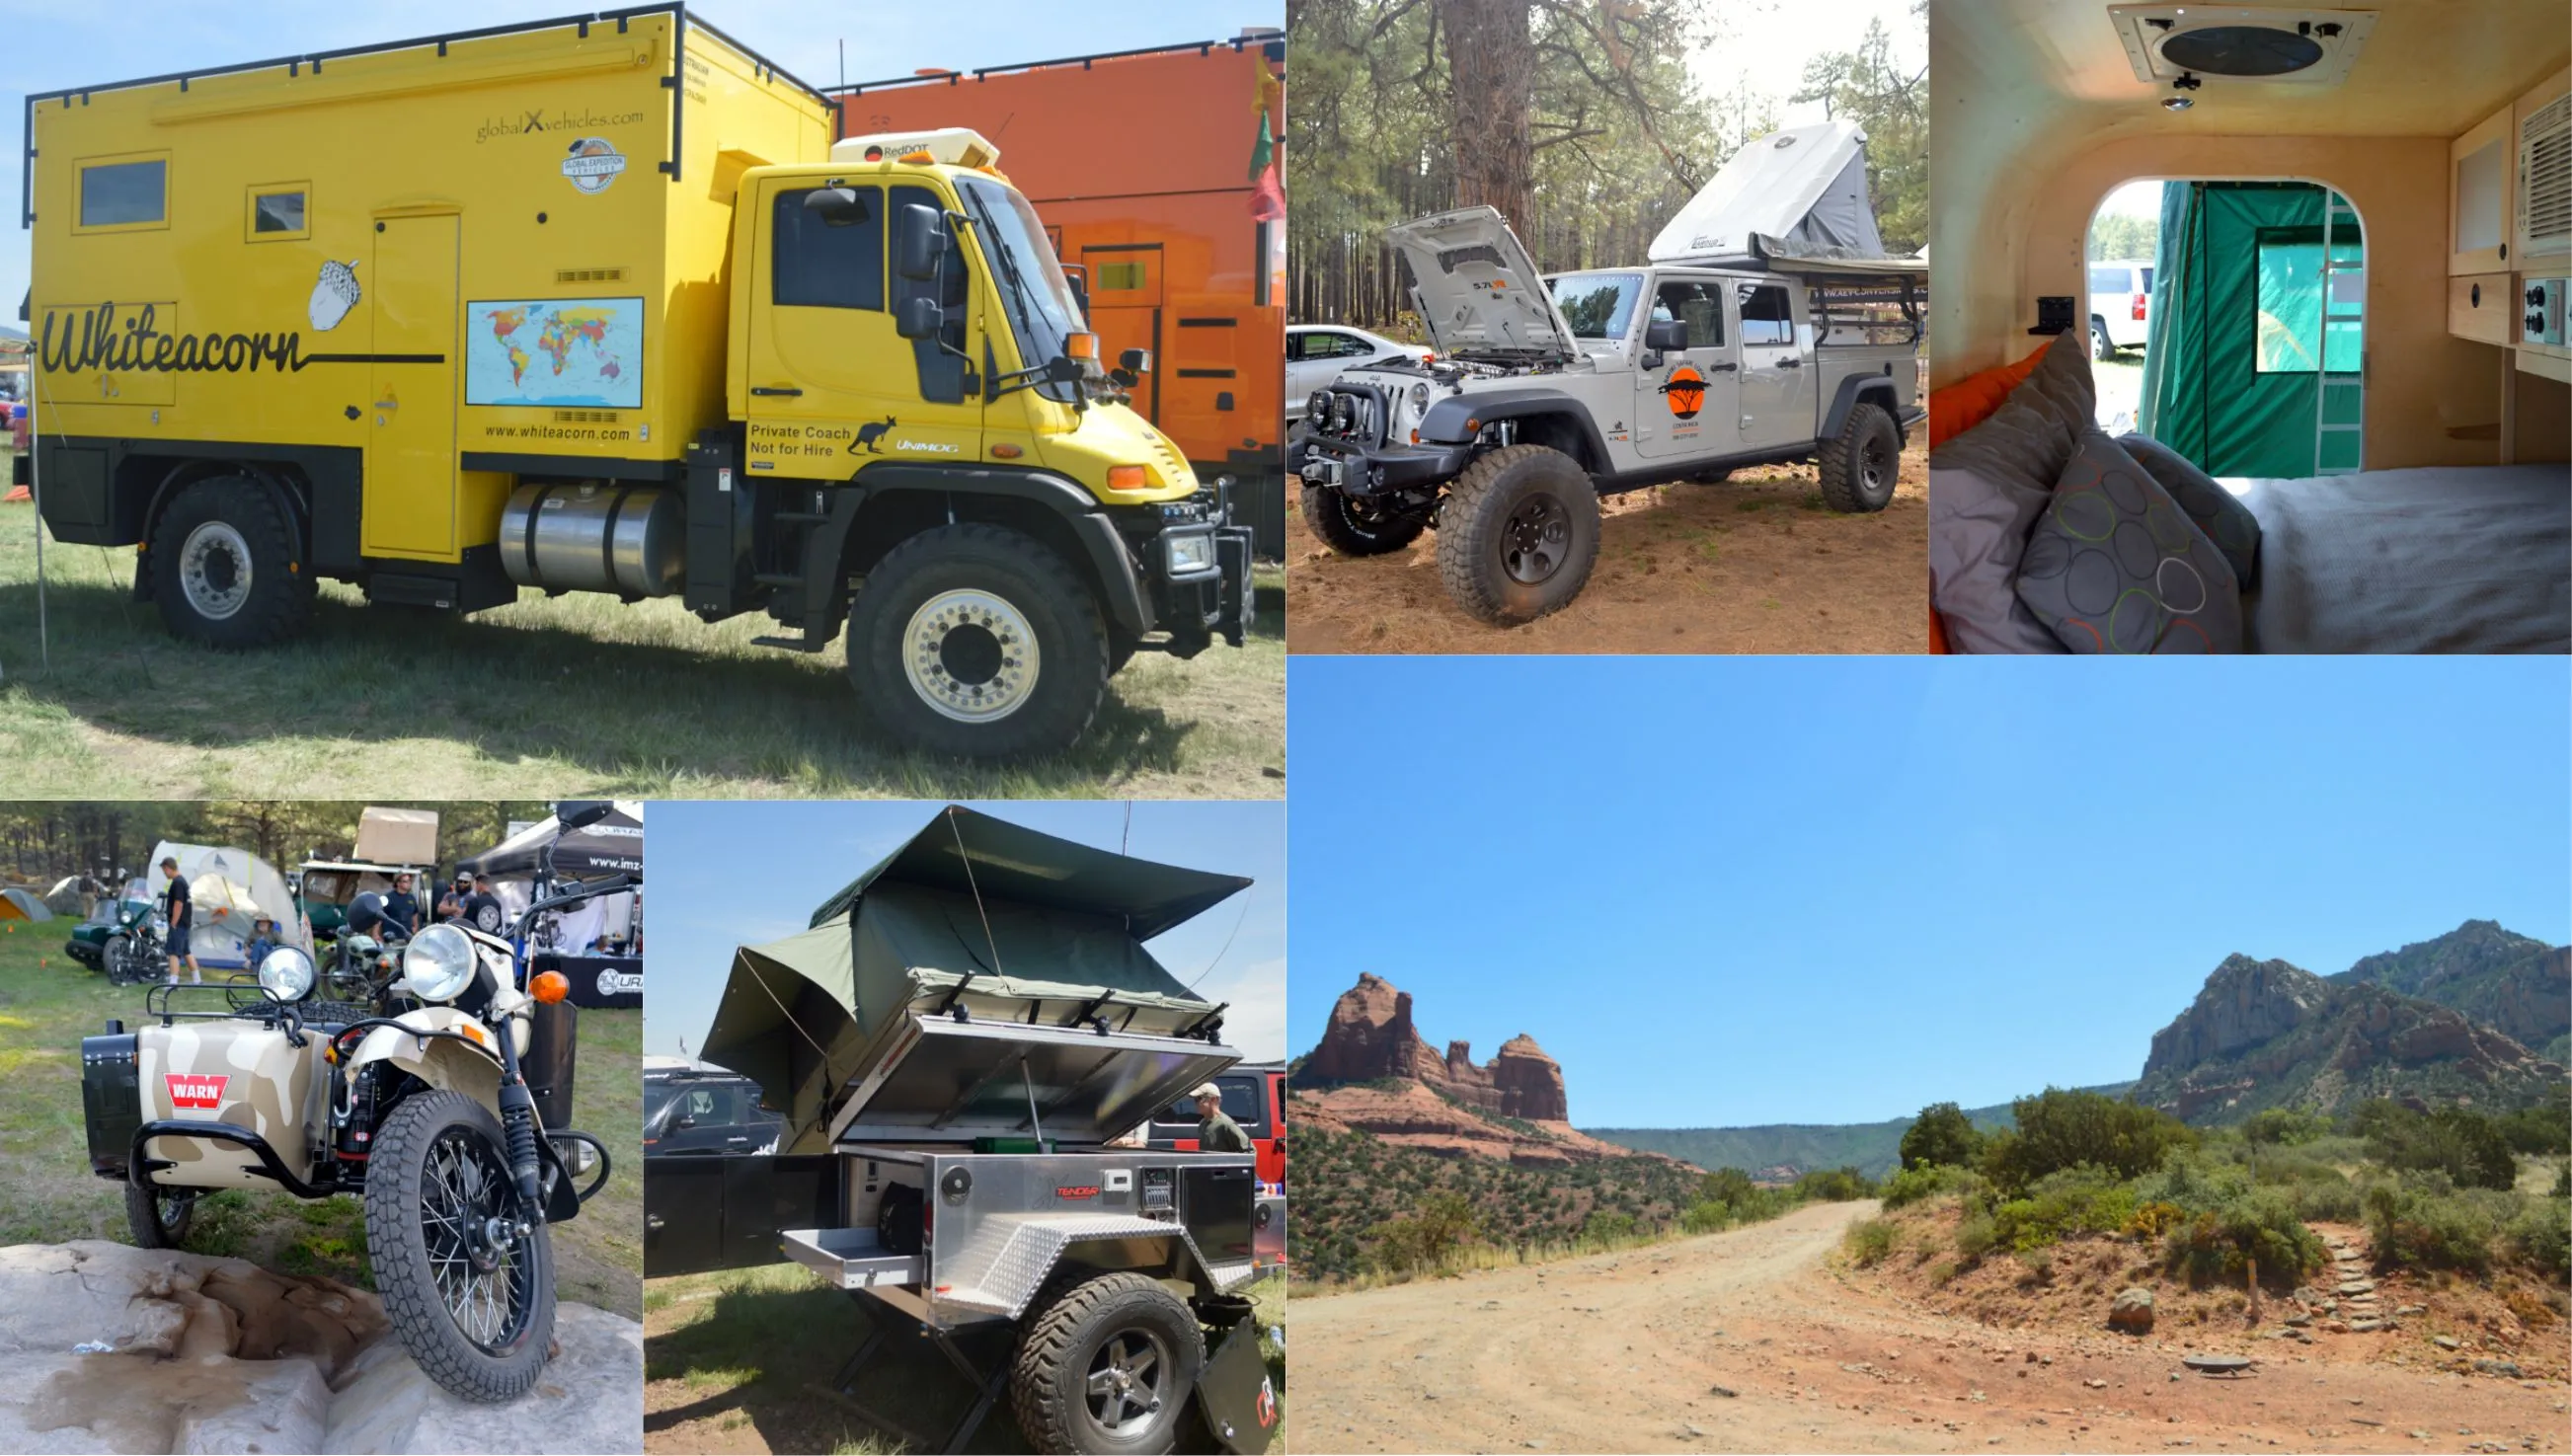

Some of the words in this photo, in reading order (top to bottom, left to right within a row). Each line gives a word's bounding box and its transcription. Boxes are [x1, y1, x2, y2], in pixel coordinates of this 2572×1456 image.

[41, 300, 301, 374] Whiteacorn
[485, 424, 630, 441] www.whiteacorn.com
[750, 424, 801, 438] Private
[805, 425, 851, 440] Coach
[750, 442, 775, 454] Not
[779, 443, 799, 455] for
[804, 443, 833, 457] Hire
[896, 439, 960, 453] UNIMOG
[619, 975, 643, 988] UR
[173, 1083, 218, 1100] WARN
